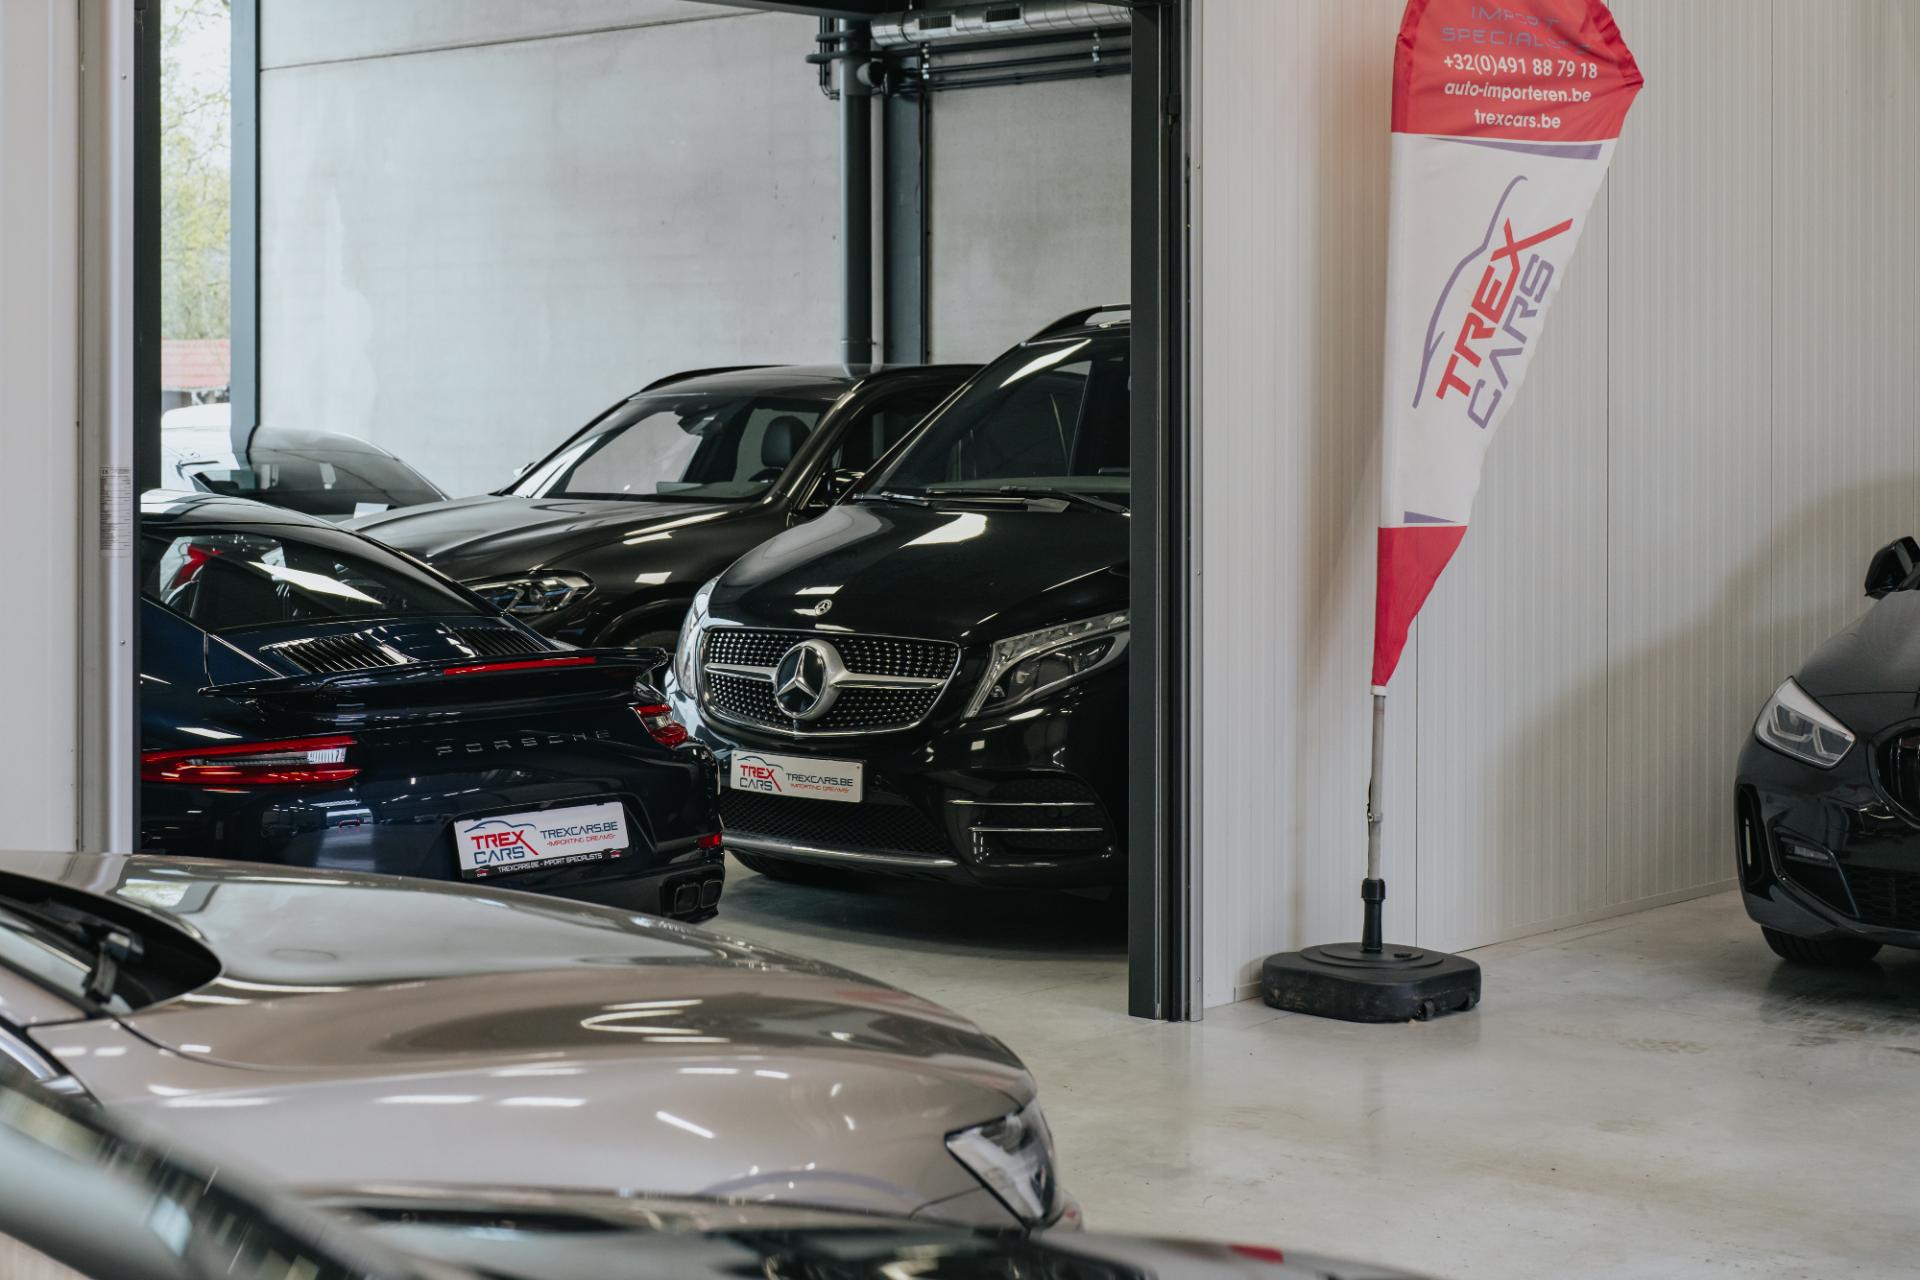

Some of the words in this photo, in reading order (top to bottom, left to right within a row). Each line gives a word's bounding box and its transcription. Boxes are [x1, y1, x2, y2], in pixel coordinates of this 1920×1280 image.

[1444, 53, 1526, 76] +32(0)491
[1533, 60, 1552, 77] 88
[1557, 61, 1576, 78] 79
[1581, 62, 1598, 79] 18
[1444, 81, 1591, 102] auto-importeren.be
[1474, 109, 1561, 129] trexcars.be
[1435, 217, 1574, 400] TREX
[1467, 253, 1555, 429] CARS
[739, 777, 773, 792] CARS
[740, 764, 782, 793] TREX
[785, 772, 854, 787] TREXCARS.BE
[540, 821, 619, 840] TREXCARS.BE
[471, 829, 539, 856] TREX
[474, 845, 525, 865] CARS
[497, 860, 540, 873] TREXCARS.BE
[544, 857, 565, 867] IMPORT
[566, 852, 603, 864] SPECIALISTS
